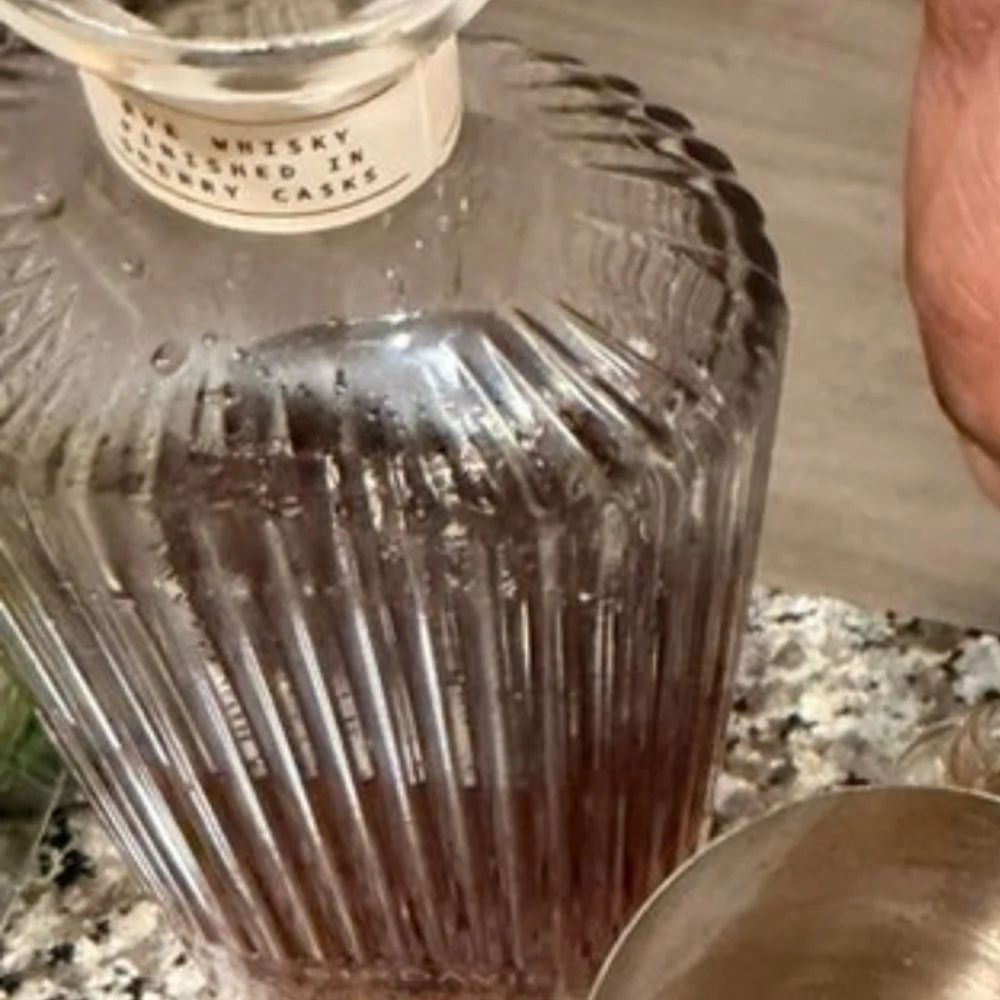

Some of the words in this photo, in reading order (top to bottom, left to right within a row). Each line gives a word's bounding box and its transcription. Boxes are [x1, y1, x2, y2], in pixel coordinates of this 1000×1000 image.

[210, 128, 349, 156] WHISKY
[329, 148, 364, 174] IN
[271, 165, 378, 203] CASKS
